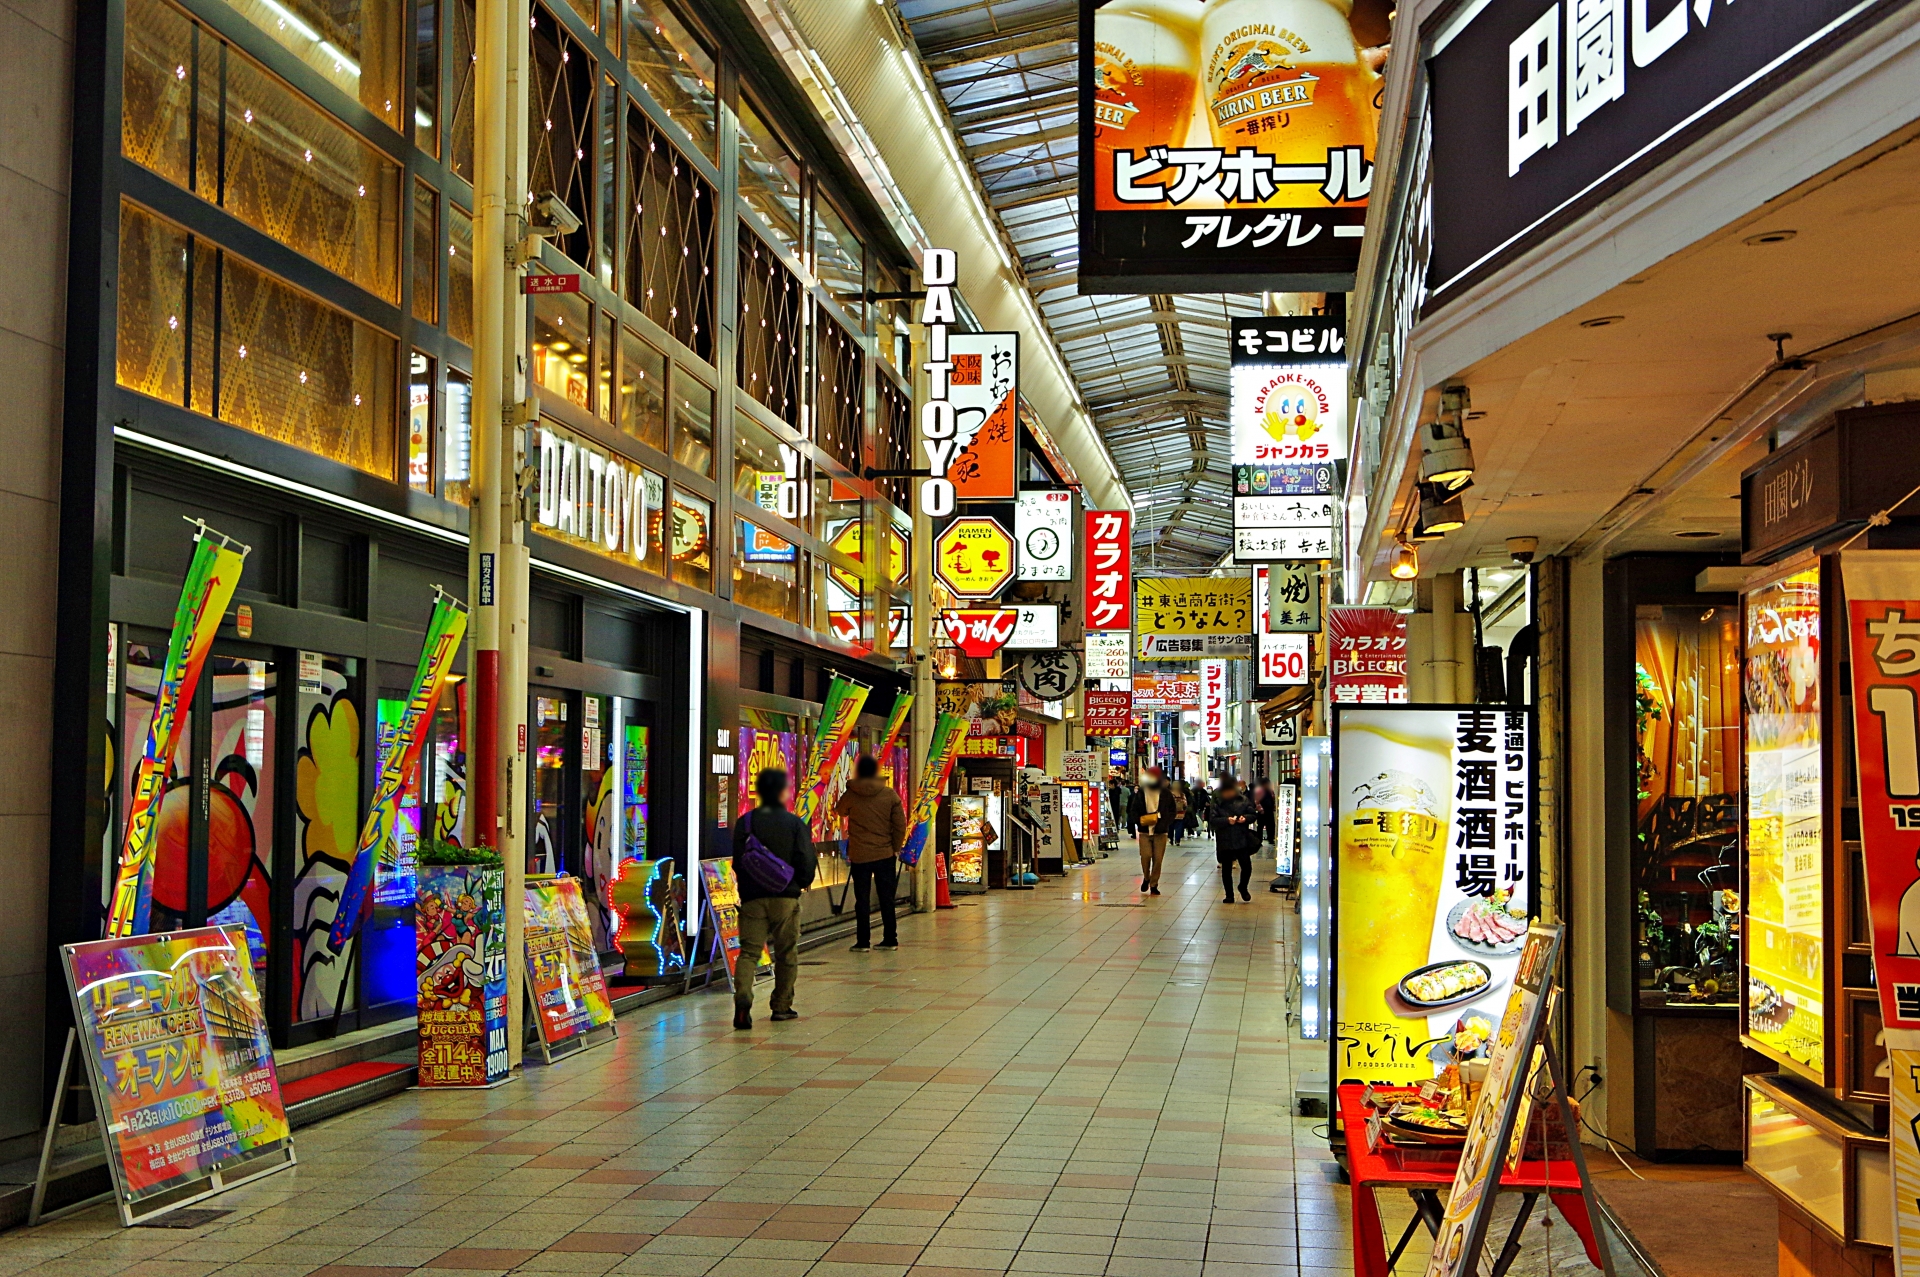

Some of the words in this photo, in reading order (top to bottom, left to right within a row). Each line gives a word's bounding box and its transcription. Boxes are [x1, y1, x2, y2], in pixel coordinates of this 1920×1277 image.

[1223, 24, 1276, 46] ORIGINAL
[1278, 28, 1311, 54] BREW
[1094, 105, 1124, 124] EER
[1217, 95, 1256, 121] KIRIN
[1260, 85, 1310, 108] BEER
[1236, 112, 1290, 135] 一番搾り
[1116, 148, 1374, 201] ビアホール
[530, 277, 566, 287] 送水口
[1238, 327, 1344, 355] モコビル
[921, 248, 958, 517] DAITOYO
[1256, 444, 1329, 460] ジャンカラ
[539, 429, 648, 561] DAITOYO
[1050, 493, 1065, 501] 3F
[1764, 458, 1814, 528] 田園ビル
[1092, 513, 1124, 627] カラオケ
[946, 610, 1014, 644] らーめん
[1154, 609, 1247, 630] どうなん?
[1099, 639, 1125, 647] ぎふや
[1156, 639, 1204, 652] 広告募集
[1031, 652, 1070, 692] 焼肉
[1333, 659, 1365, 676] BIG
[1368, 659, 1407, 675] ECHO
[1089, 696, 1104, 704] BIG
[1105, 696, 1127, 704] ECHO
[1157, 681, 1199, 698] 大東洋
[1335, 684, 1408, 704] 営業中
[1087, 707, 1129, 717] カラオケ
[1207, 664, 1222, 743] ジャンカラ
[1505, 711, 1525, 772] 東通り
[1456, 711, 1497, 898] 麦酒酒場
[1505, 781, 1525, 881] ビアホール
[91, 964, 201, 1023] リニューアル
[421, 1010, 483, 1022] 地域最大級
[421, 1023, 482, 1035] JUGGLER
[105, 1015, 167, 1050] RENEWAL
[168, 1010, 202, 1036] OPEN
[489, 1027, 505, 1053] MAX
[423, 1044, 482, 1064] 全114台
[486, 1049, 508, 1077] 19000
[433, 1065, 473, 1080] 設置中
